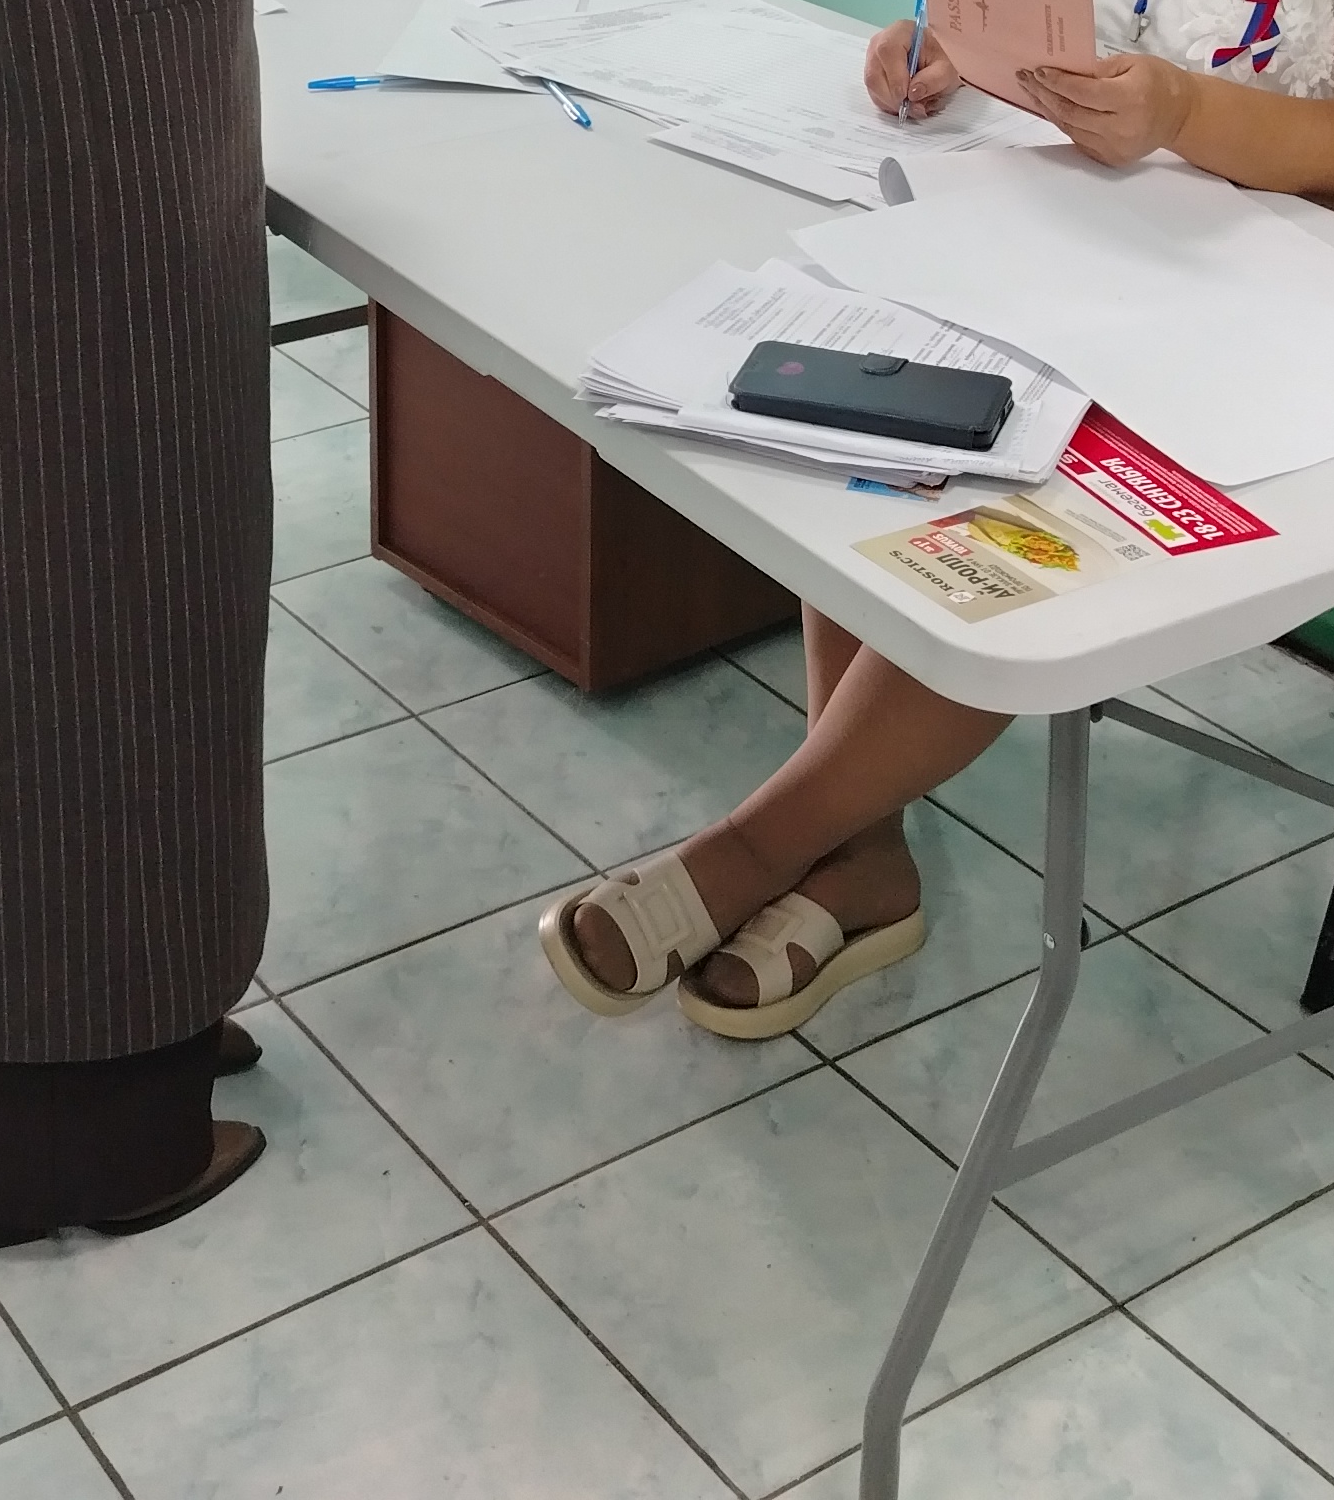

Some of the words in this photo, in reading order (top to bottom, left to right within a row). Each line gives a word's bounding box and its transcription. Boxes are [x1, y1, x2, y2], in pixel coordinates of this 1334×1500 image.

[1099, 457, 1182, 509] СЕНТЯБРЯ
[1171, 508, 1225, 541] 18-23
[889, 550, 954, 592] ROSTIC'S
[936, 553, 1016, 599] АЙ-РОЛЛ
